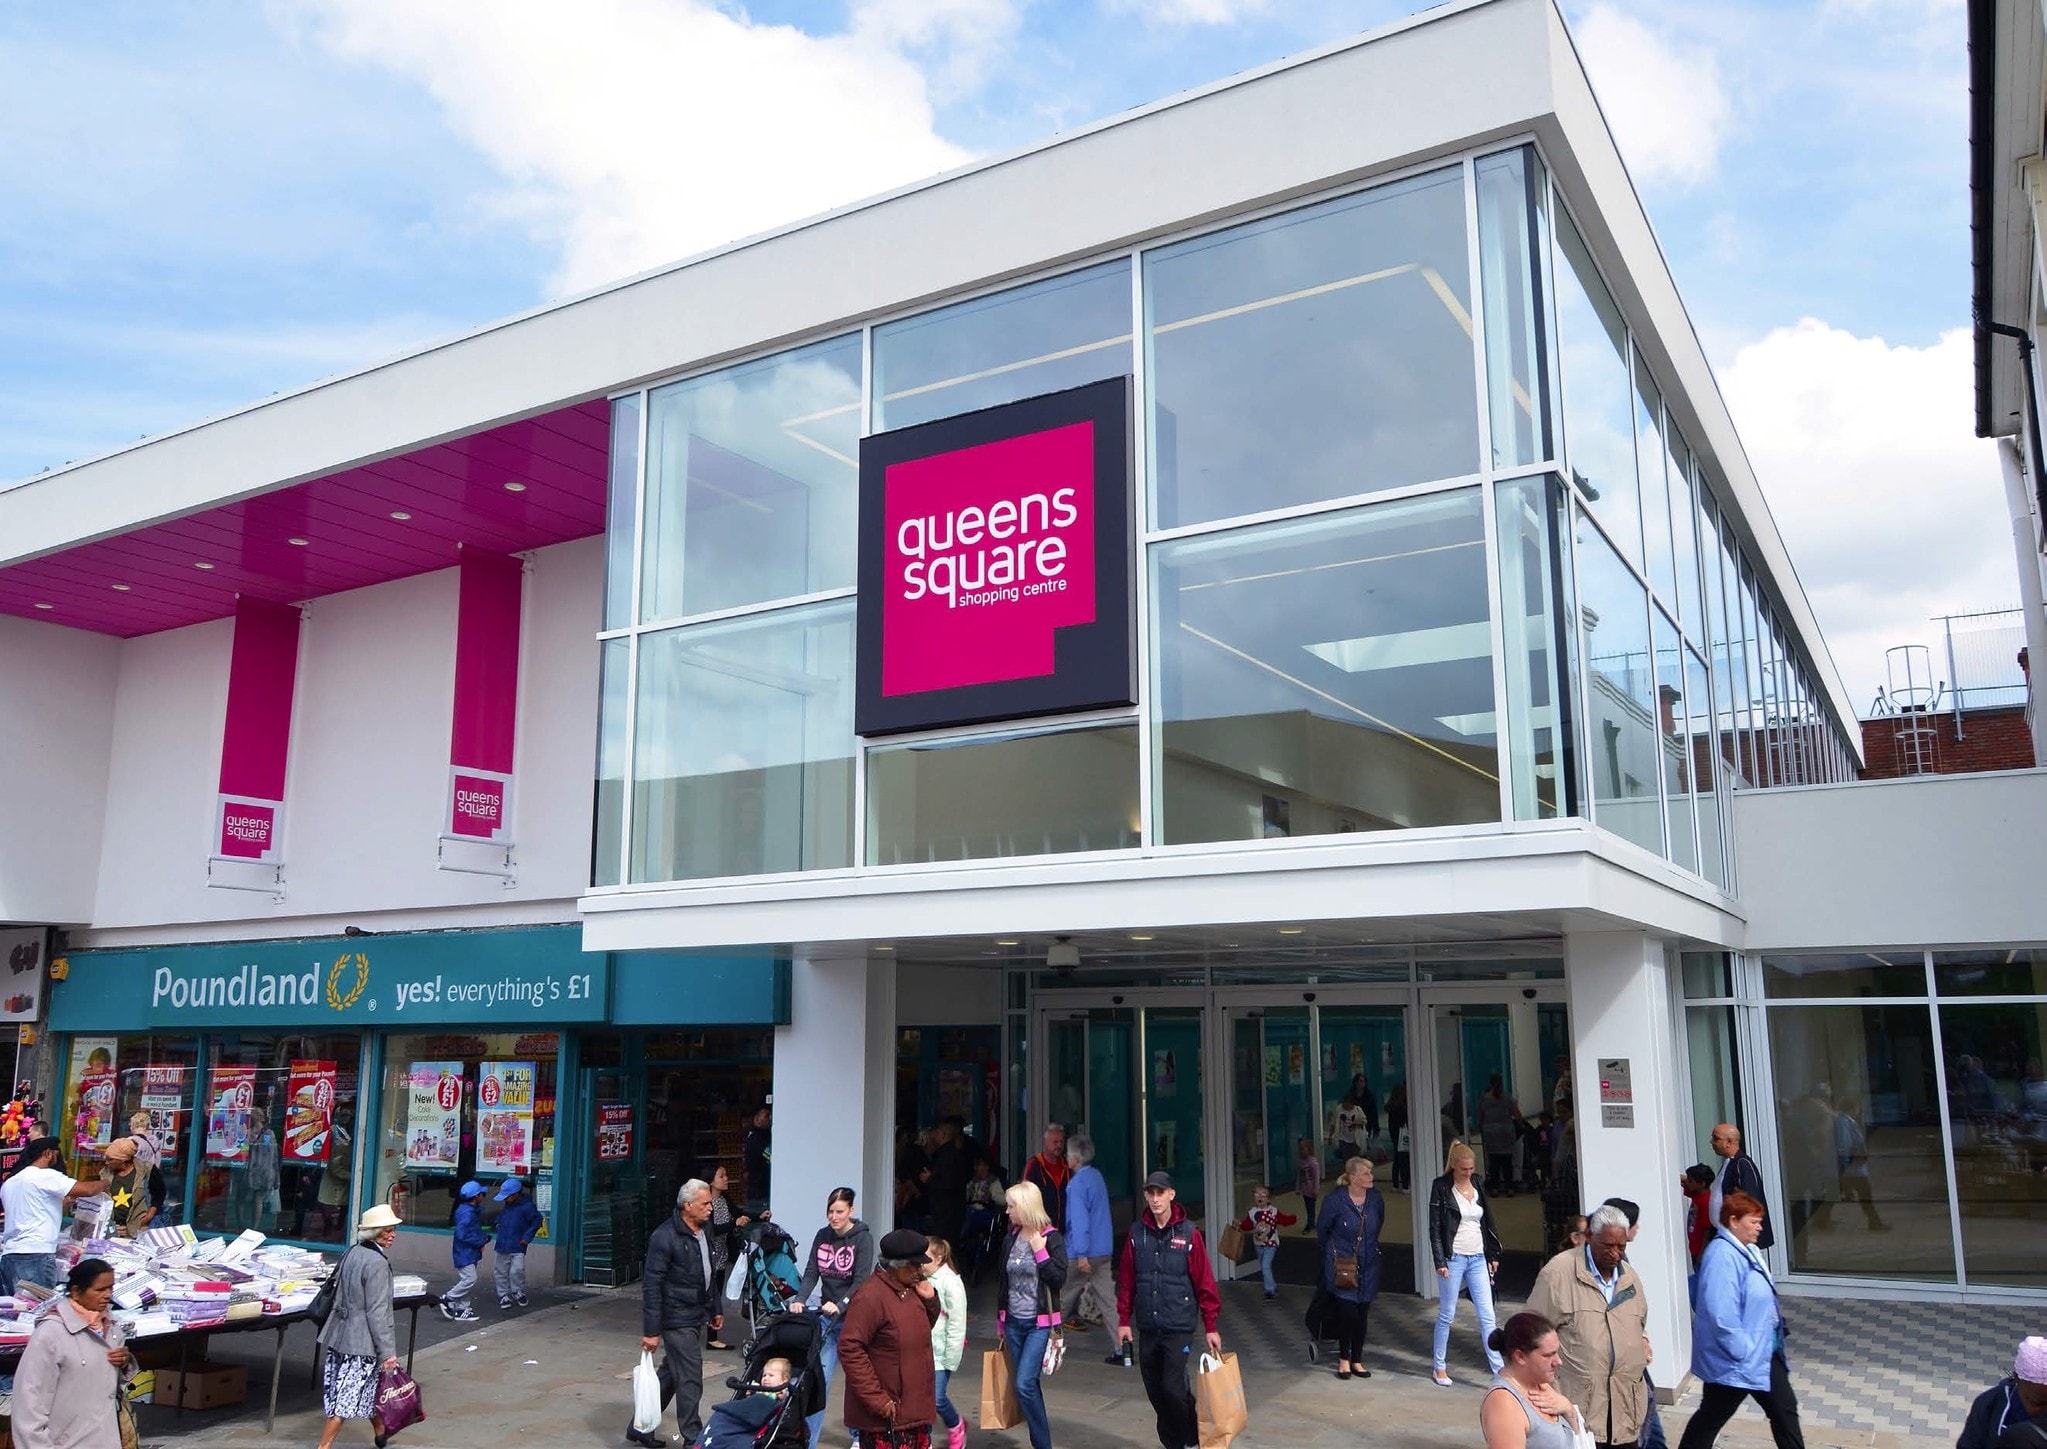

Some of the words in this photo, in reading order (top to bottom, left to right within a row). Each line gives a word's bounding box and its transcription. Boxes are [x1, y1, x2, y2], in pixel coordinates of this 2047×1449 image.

[898, 487, 1078, 559] queens
[903, 537, 1067, 608] square
[959, 586, 1019, 607] shopping
[1023, 578, 1068, 597] centre
[457, 790, 500, 806] queens
[458, 801, 497, 817] square
[226, 816, 270, 830] queens
[227, 826, 267, 840] square
[152, 962, 320, 1008] Poundland
[396, 975, 442, 1010] yes!
[447, 976, 560, 1007] everything's
[567, 974, 591, 999] £1
[147, 1069, 165, 1083] 15%
[167, 1068, 180, 1083] Off
[514, 1069, 532, 1080] FOR
[237, 1088, 251, 1108] £1
[414, 1094, 436, 1104] New!
[442, 1092, 455, 1107] £1
[485, 1091, 498, 1105] £2
[502, 1091, 531, 1105] VALUE
[605, 1110, 618, 1119] 15%
[619, 1110, 628, 1118] Off
